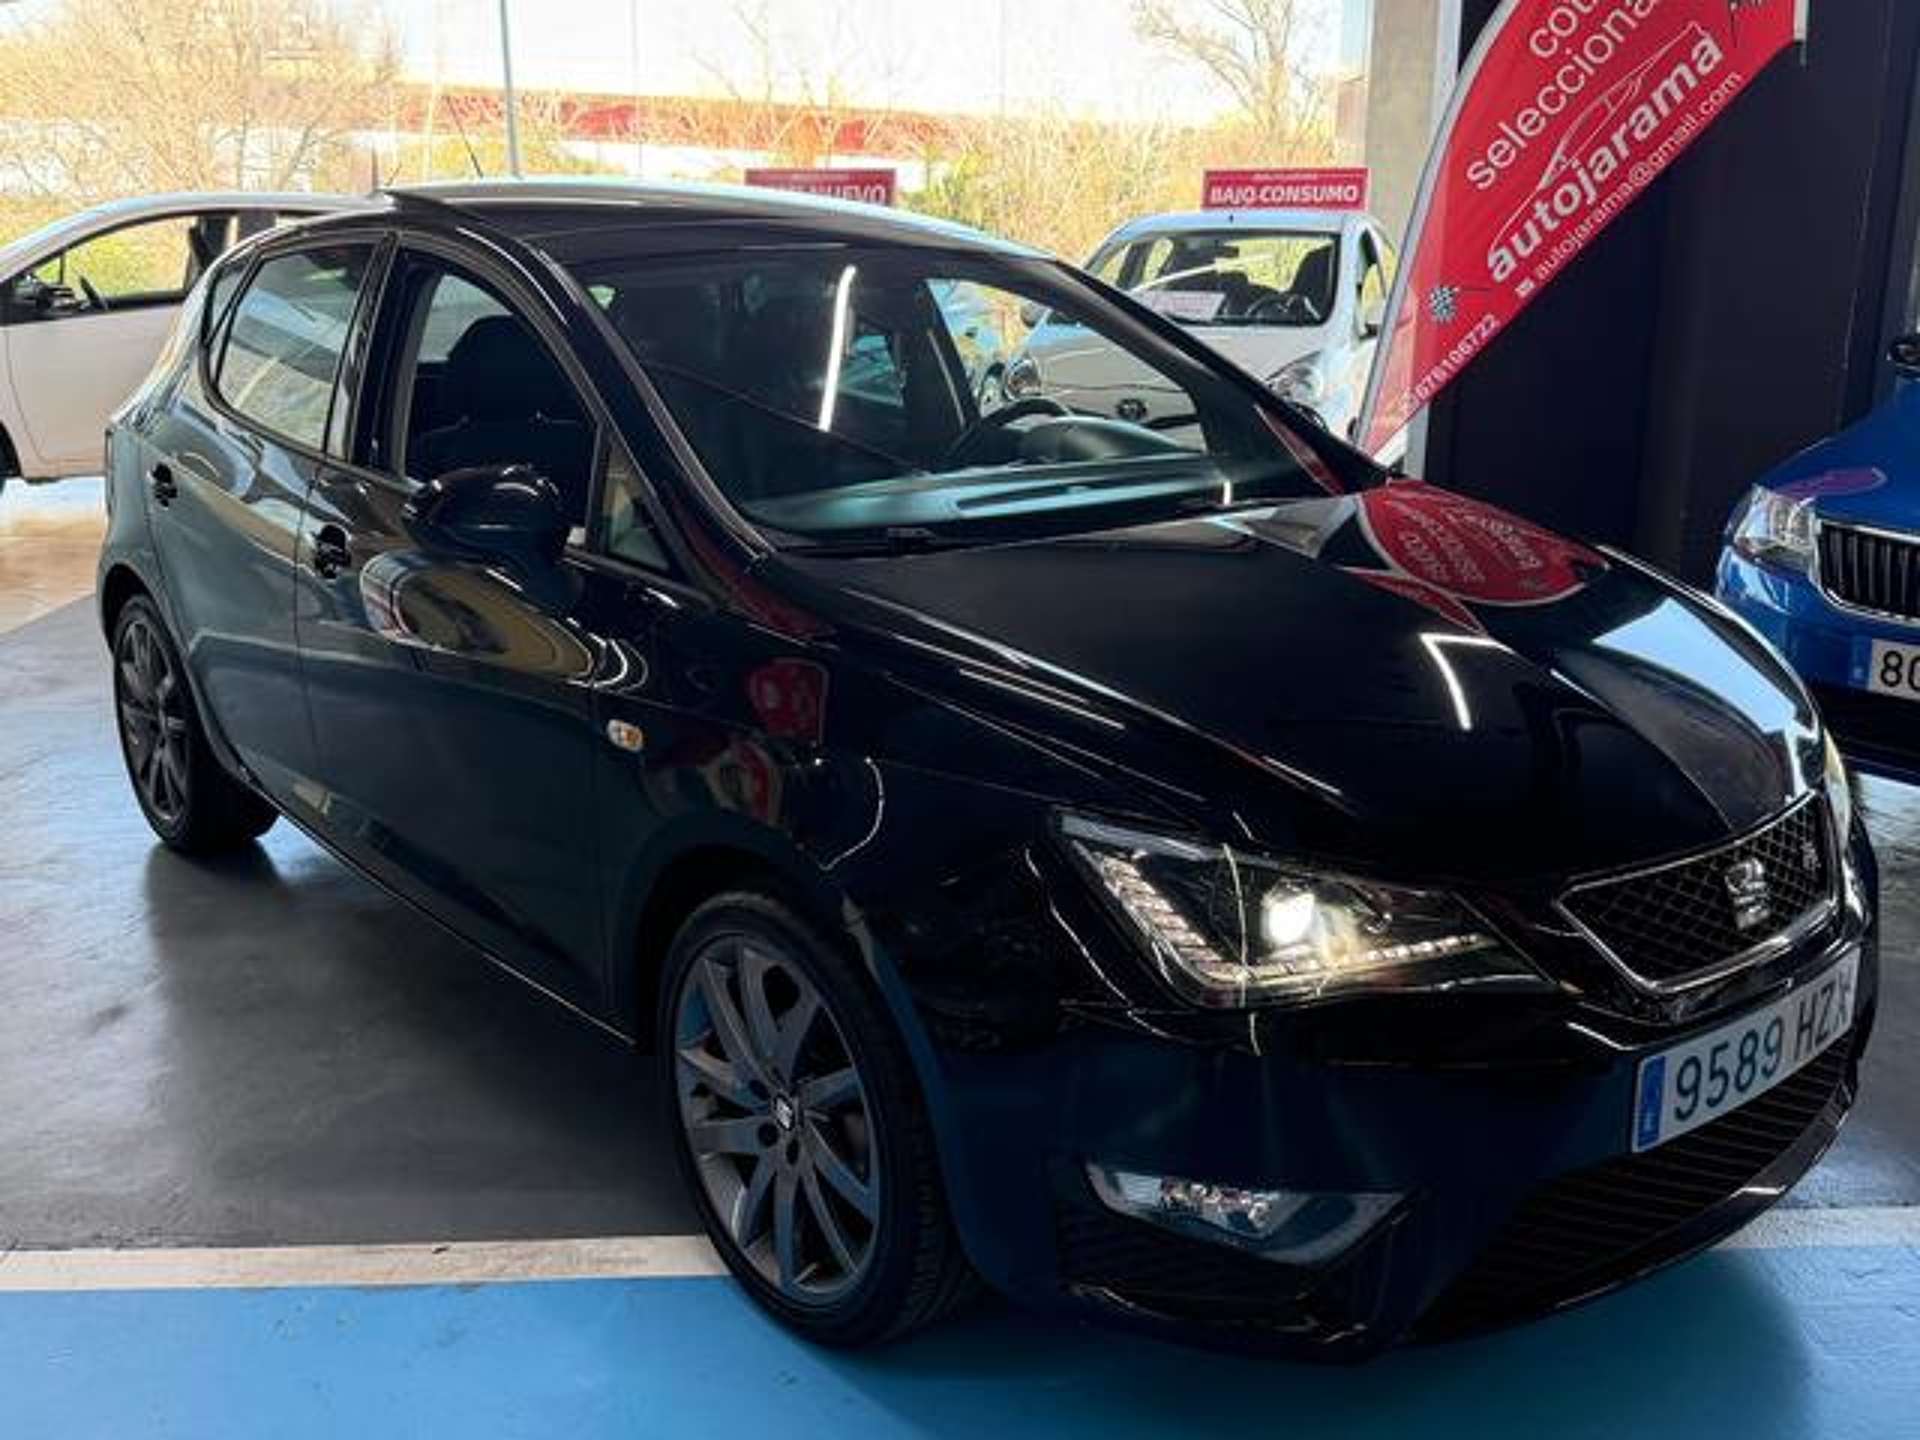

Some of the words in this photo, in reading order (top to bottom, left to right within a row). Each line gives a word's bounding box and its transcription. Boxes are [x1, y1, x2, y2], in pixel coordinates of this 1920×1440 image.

[1210, 186, 1255, 205] BAJO
[1258, 184, 1360, 203] CONSUMO
[1486, 31, 1724, 283] autojarama
[1535, 71, 1743, 280] autojarama@gmail.com
[1674, 1016, 1784, 1121] 9589
